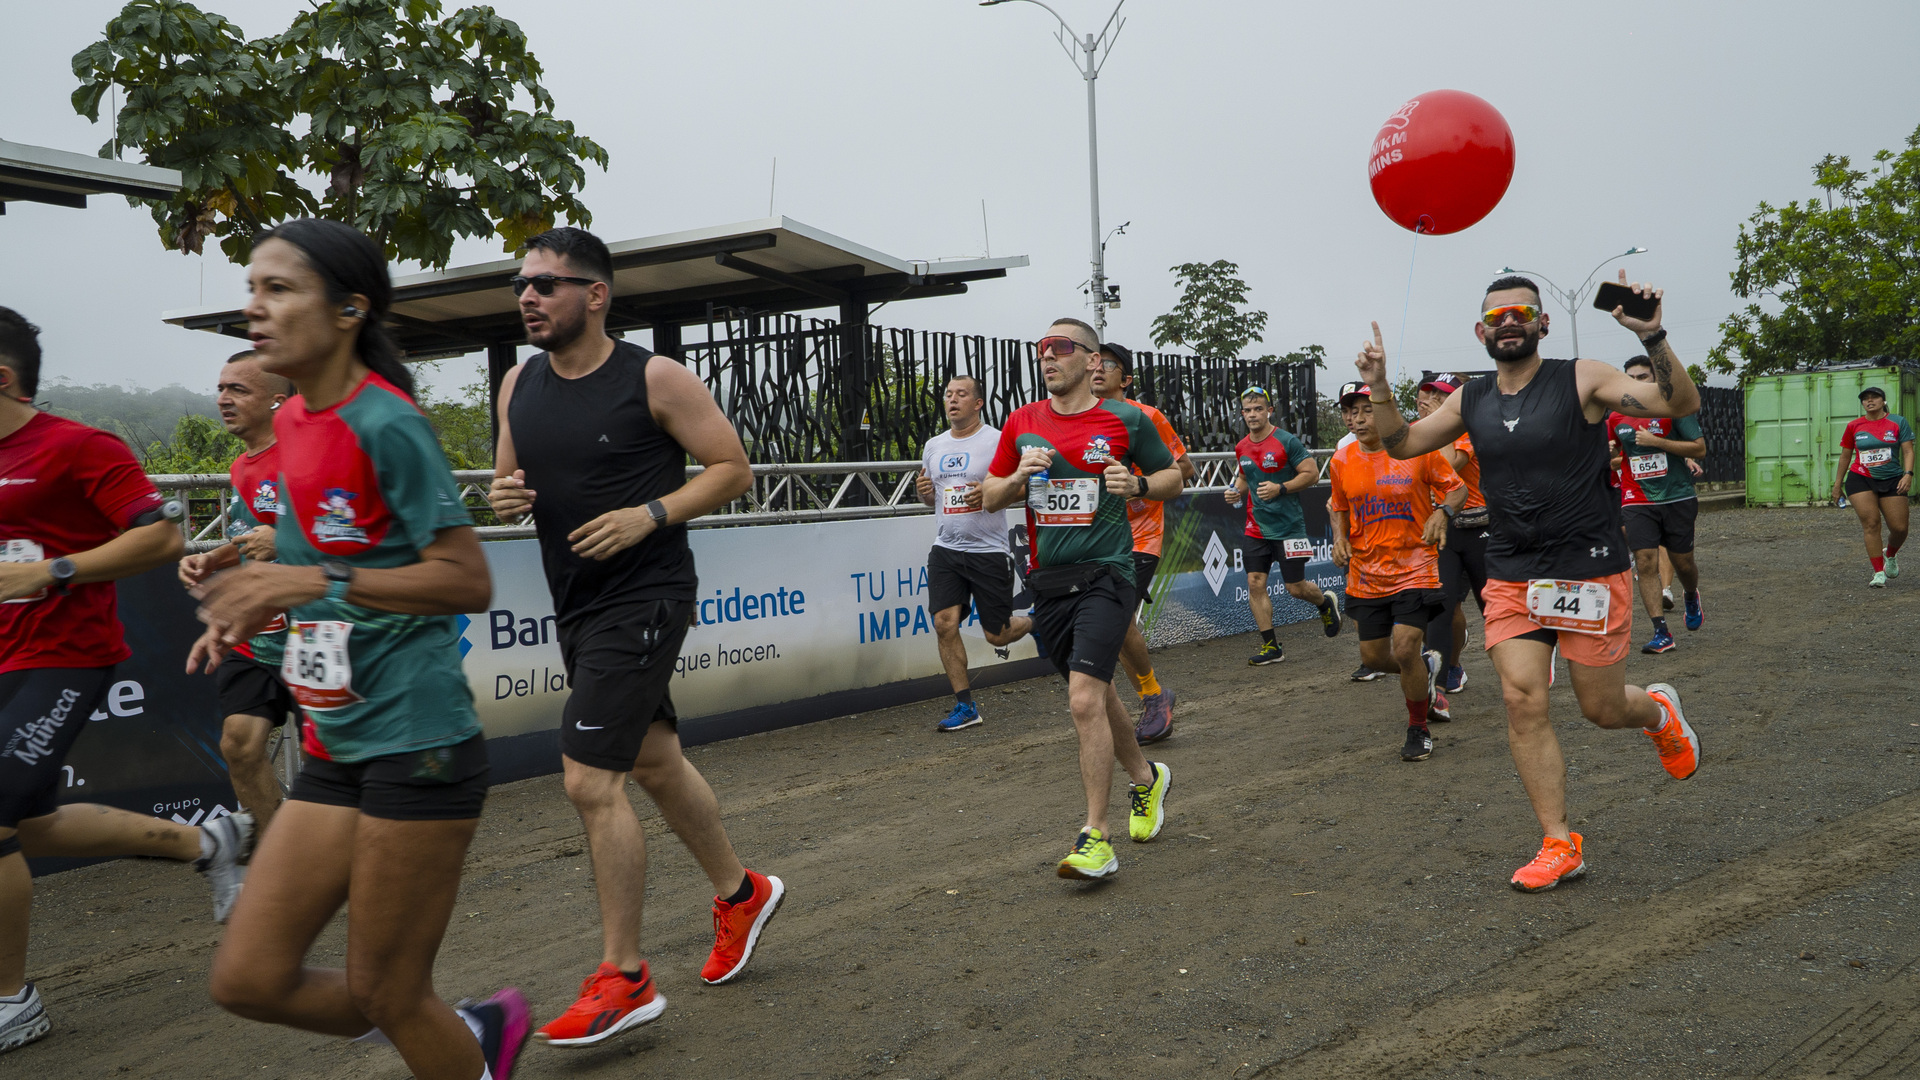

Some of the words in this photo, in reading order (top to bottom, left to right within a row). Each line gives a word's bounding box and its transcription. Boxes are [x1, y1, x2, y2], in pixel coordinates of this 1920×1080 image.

[1638, 461, 1658, 472] 654
[1867, 454, 1884, 462] 362
[951, 495, 965, 506] 84
[1047, 494, 1081, 511] 502
[1364, 493, 1377, 505] La
[1353, 498, 1413, 523] Muñeca
[1293, 541, 1309, 550] 631
[851, 572, 885, 604] TU
[898, 566, 929, 598] HA
[1317, 573, 1344, 588] hacen.
[1553, 595, 1581, 615] 44
[489, 609, 561, 651] Ban
[495, 668, 536, 701] Del
[543, 667, 566, 693] la
[674, 653, 711, 678] que
[717, 643, 781, 667] hacen.
[13, 688, 81, 766] Muñeca
[16, 722, 39, 739] La
[153, 798, 201, 813] Grupo
